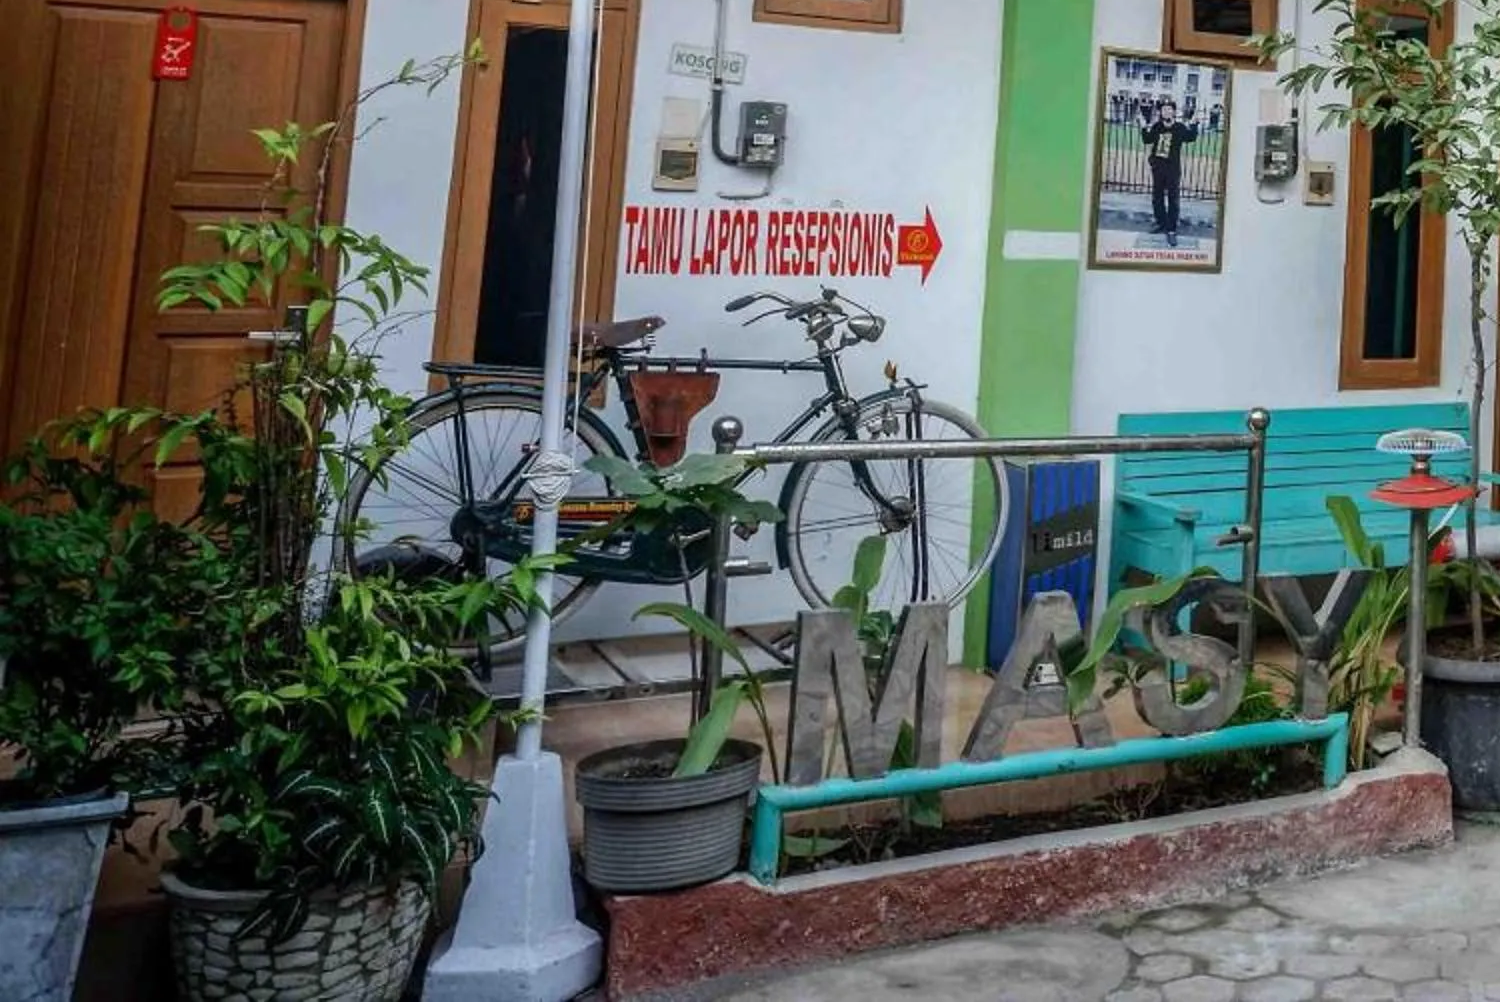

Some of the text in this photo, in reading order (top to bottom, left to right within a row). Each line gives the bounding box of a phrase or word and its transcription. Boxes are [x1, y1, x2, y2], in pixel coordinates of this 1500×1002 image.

[625, 205, 896, 279] TAMU LAPOR RESEPSIONIS
[783, 568, 1373, 787] MASY
